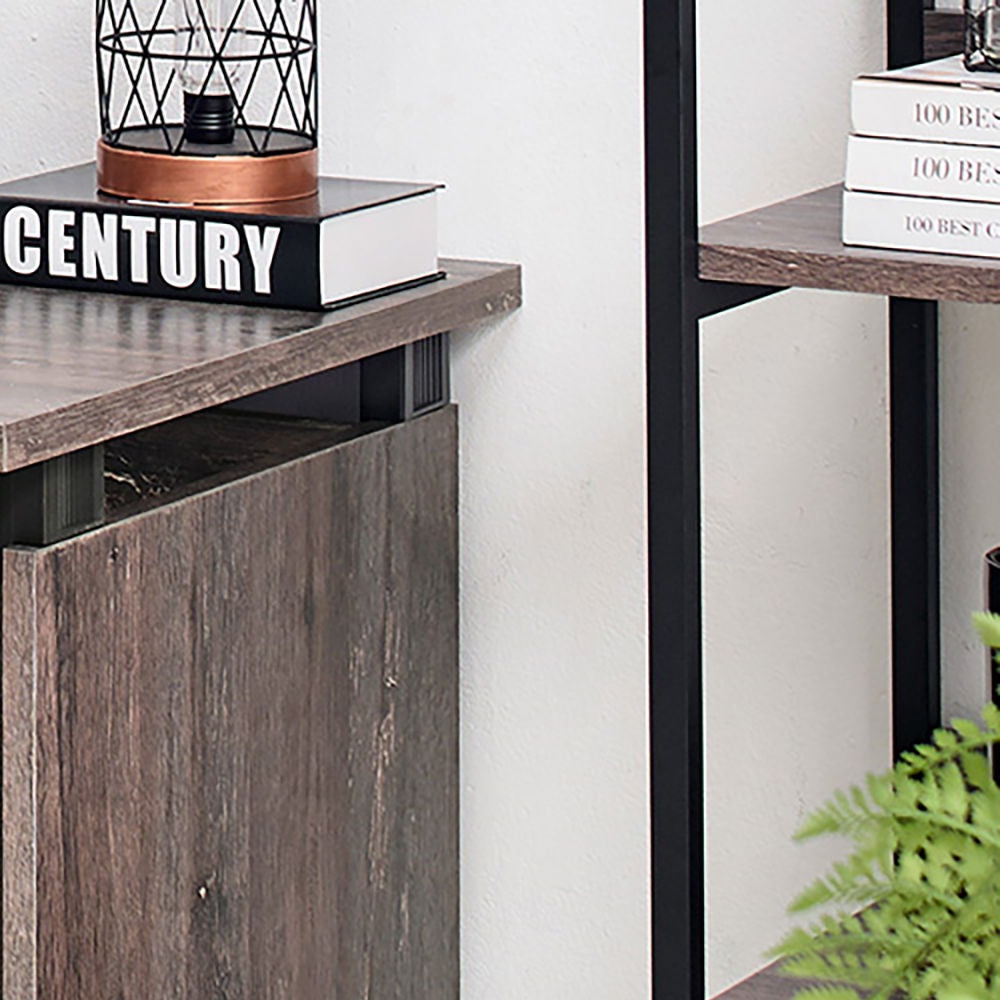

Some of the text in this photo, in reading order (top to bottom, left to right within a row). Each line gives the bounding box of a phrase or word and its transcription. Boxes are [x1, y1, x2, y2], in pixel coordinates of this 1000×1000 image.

[915, 103, 950, 125] 100
[913, 156, 950, 179] 100
[905, 215, 933, 233] 100
[938, 218, 983, 238] BEST
[3, 205, 281, 295] CENTURY
